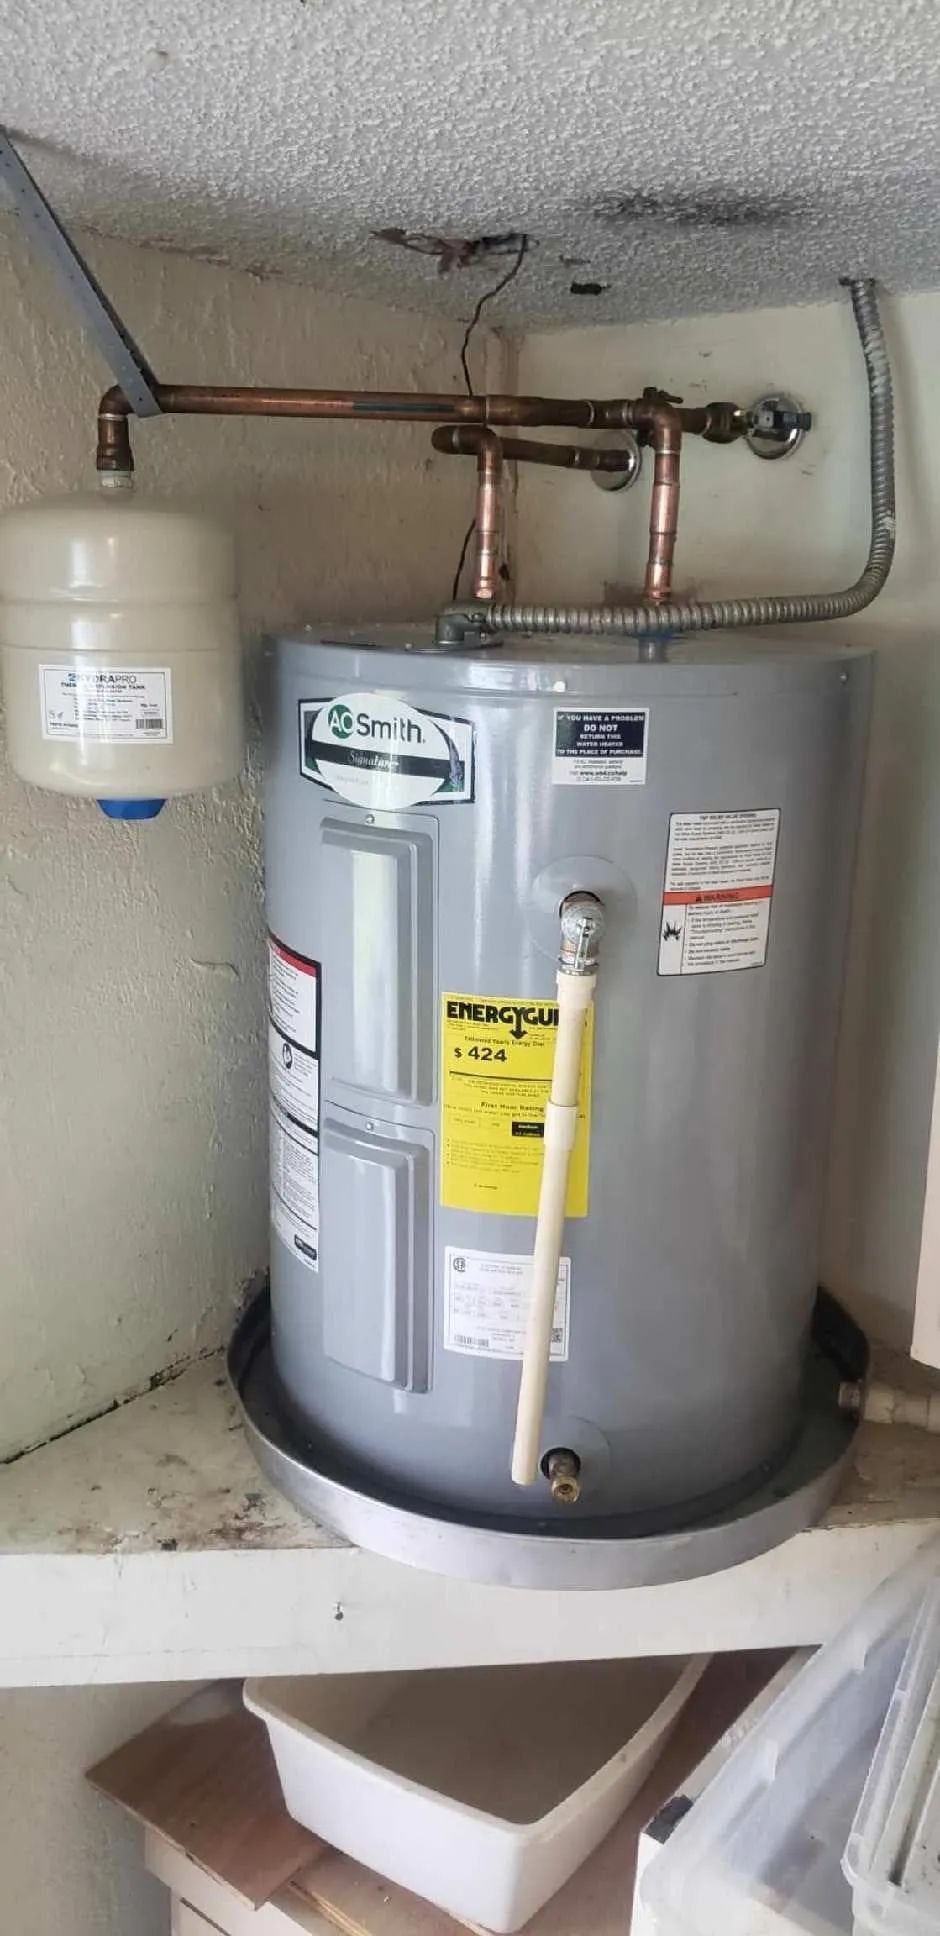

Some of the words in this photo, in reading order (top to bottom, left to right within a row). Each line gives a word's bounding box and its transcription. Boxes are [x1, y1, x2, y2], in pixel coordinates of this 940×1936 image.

[583, 724, 597, 732] DO
[599, 724, 618, 732] NOT
[454, 1047, 462, 1059] $
[468, 1046, 508, 1062] 424
[481, 1101, 498, 1109] First
